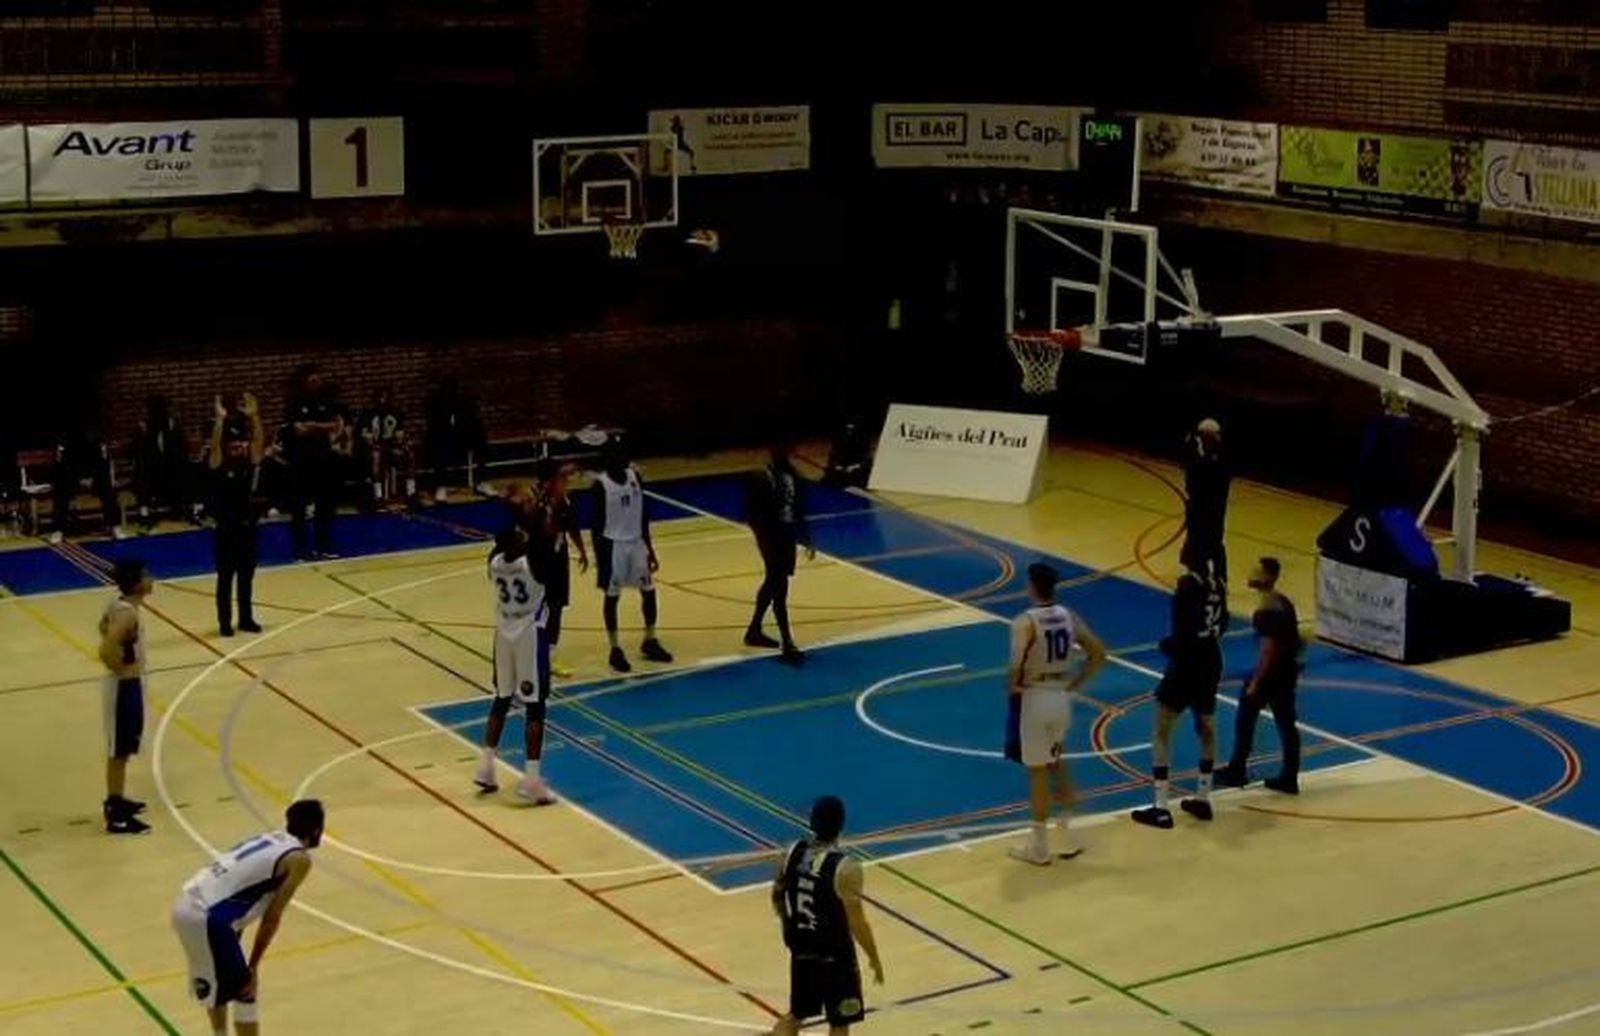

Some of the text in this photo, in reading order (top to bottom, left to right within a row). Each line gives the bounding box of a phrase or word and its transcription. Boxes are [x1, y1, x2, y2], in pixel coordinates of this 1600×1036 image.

[894, 121, 957, 138] EL BAR
[981, 119, 1008, 141] La
[53, 129, 196, 157] Avant
[144, 159, 191, 172] Grup
[345, 127, 368, 188] 1
[958, 427, 986, 445] del
[989, 429, 1028, 448] Prat
[496, 577, 529, 603] 33
[1045, 628, 1069, 663] 10
